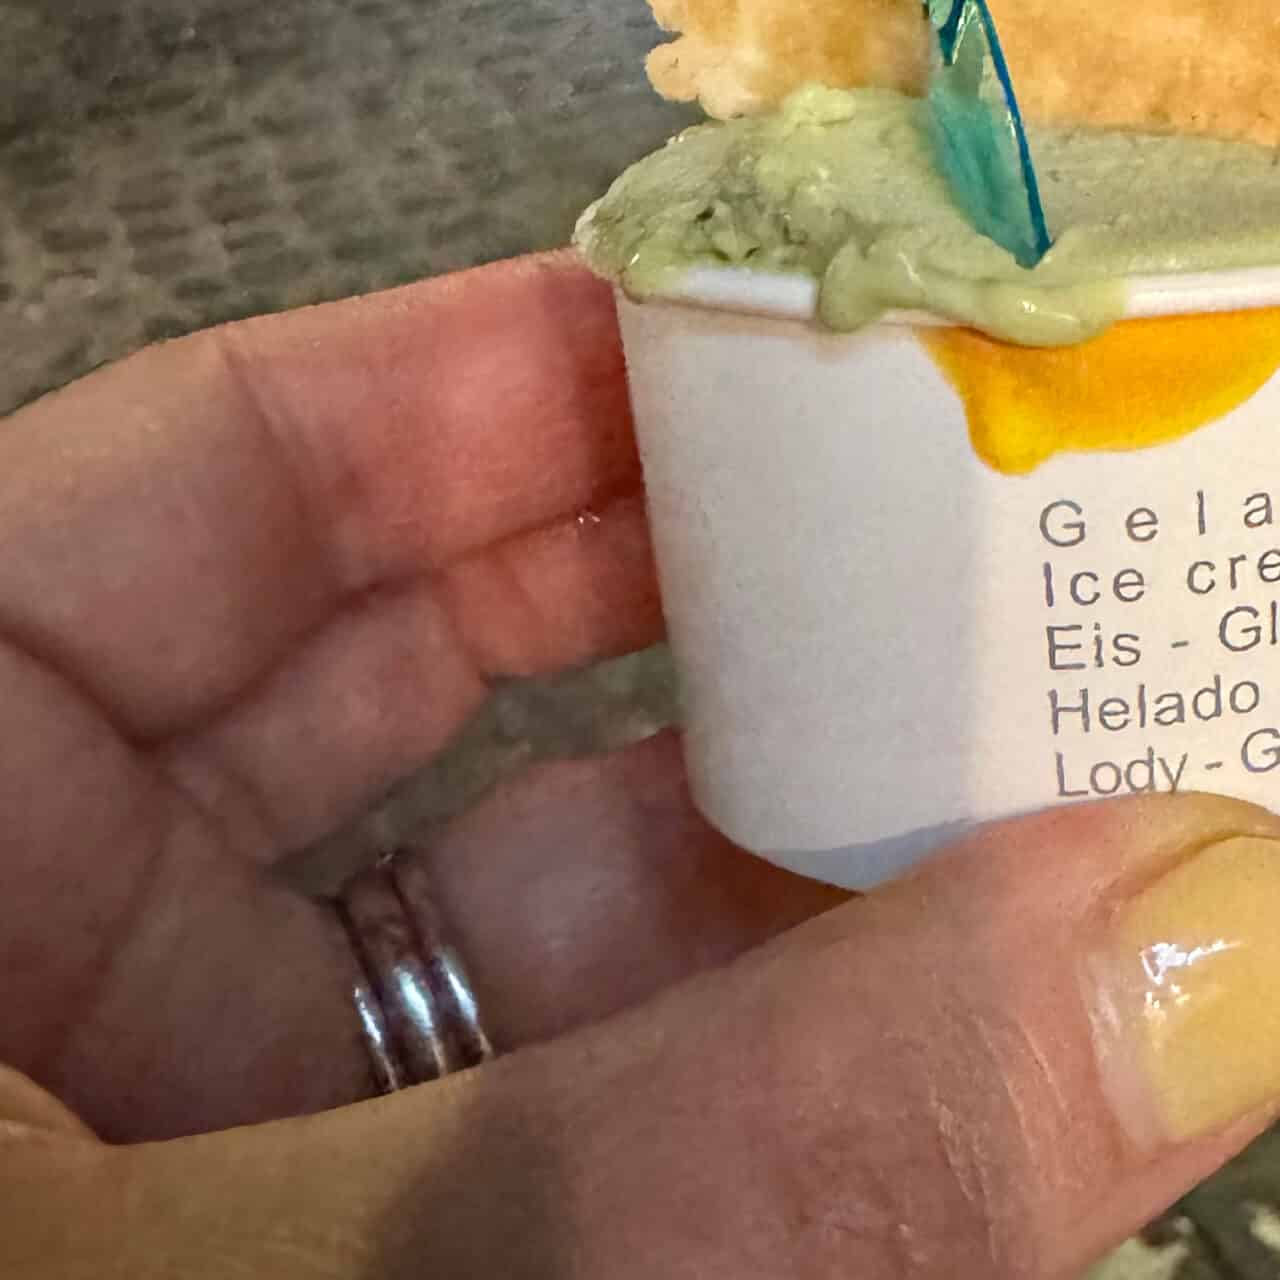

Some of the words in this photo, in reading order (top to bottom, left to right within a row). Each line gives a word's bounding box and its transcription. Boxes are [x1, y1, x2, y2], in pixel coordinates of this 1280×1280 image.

[1042, 561, 1147, 608] Ice
[1045, 621, 1143, 671] Eis
[1047, 673, 1262, 736] Helado
[1055, 745, 1189, 797] Lody
